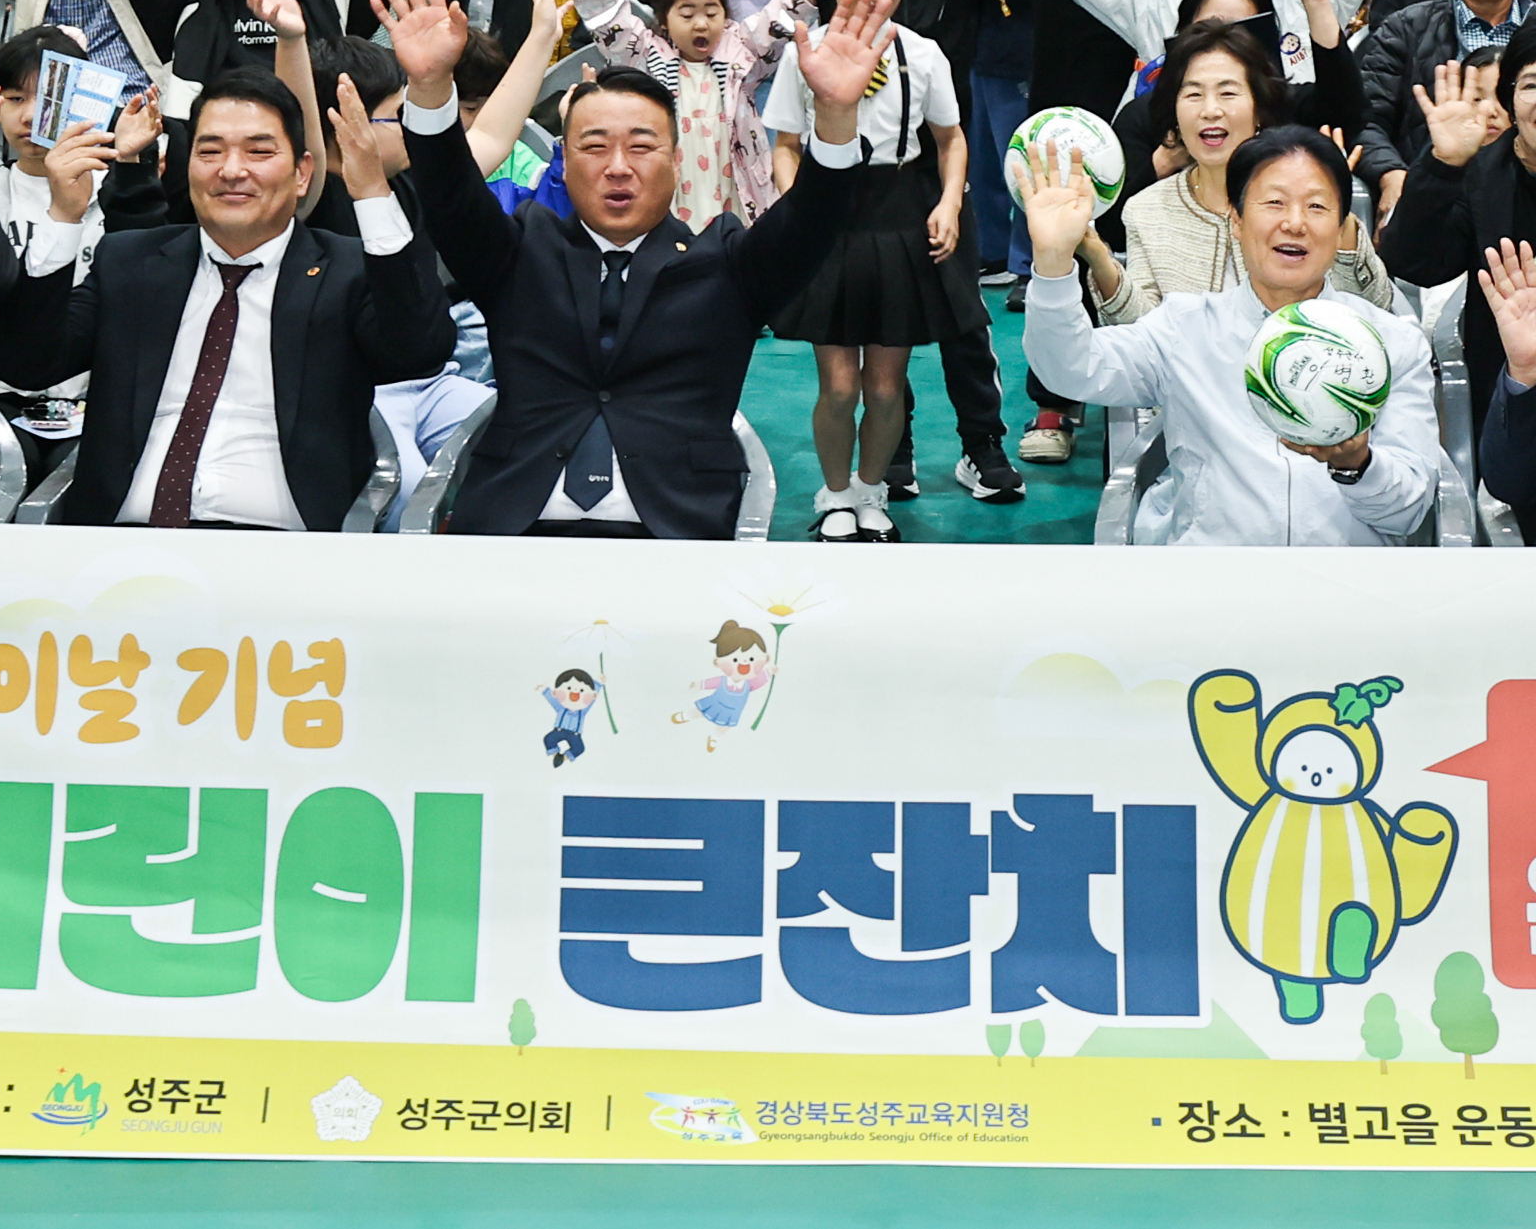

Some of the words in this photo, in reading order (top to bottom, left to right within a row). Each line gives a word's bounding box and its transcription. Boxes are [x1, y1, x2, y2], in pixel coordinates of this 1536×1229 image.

[176, 633, 347, 750] 기념
[555, 790, 1201, 1020] 큰잔치
[124, 1077, 228, 1115] 성주군
[755, 1100, 1030, 1128] 경상북도성주교육지원청
[120, 1119, 190, 1132] SEONGJU
[191, 1121, 223, 1133] GUN
[396, 1098, 571, 1133] 성주군의회
[1177, 1100, 1266, 1144] 장소
[1308, 1102, 1440, 1146] 별고을
[758, 1131, 865, 1143] Gyeongsangbukdo
[868, 1131, 915, 1143] Seongju
[919, 1132, 954, 1143] Office
[956, 1132, 969, 1143] of
[973, 1133, 1030, 1144] Education
